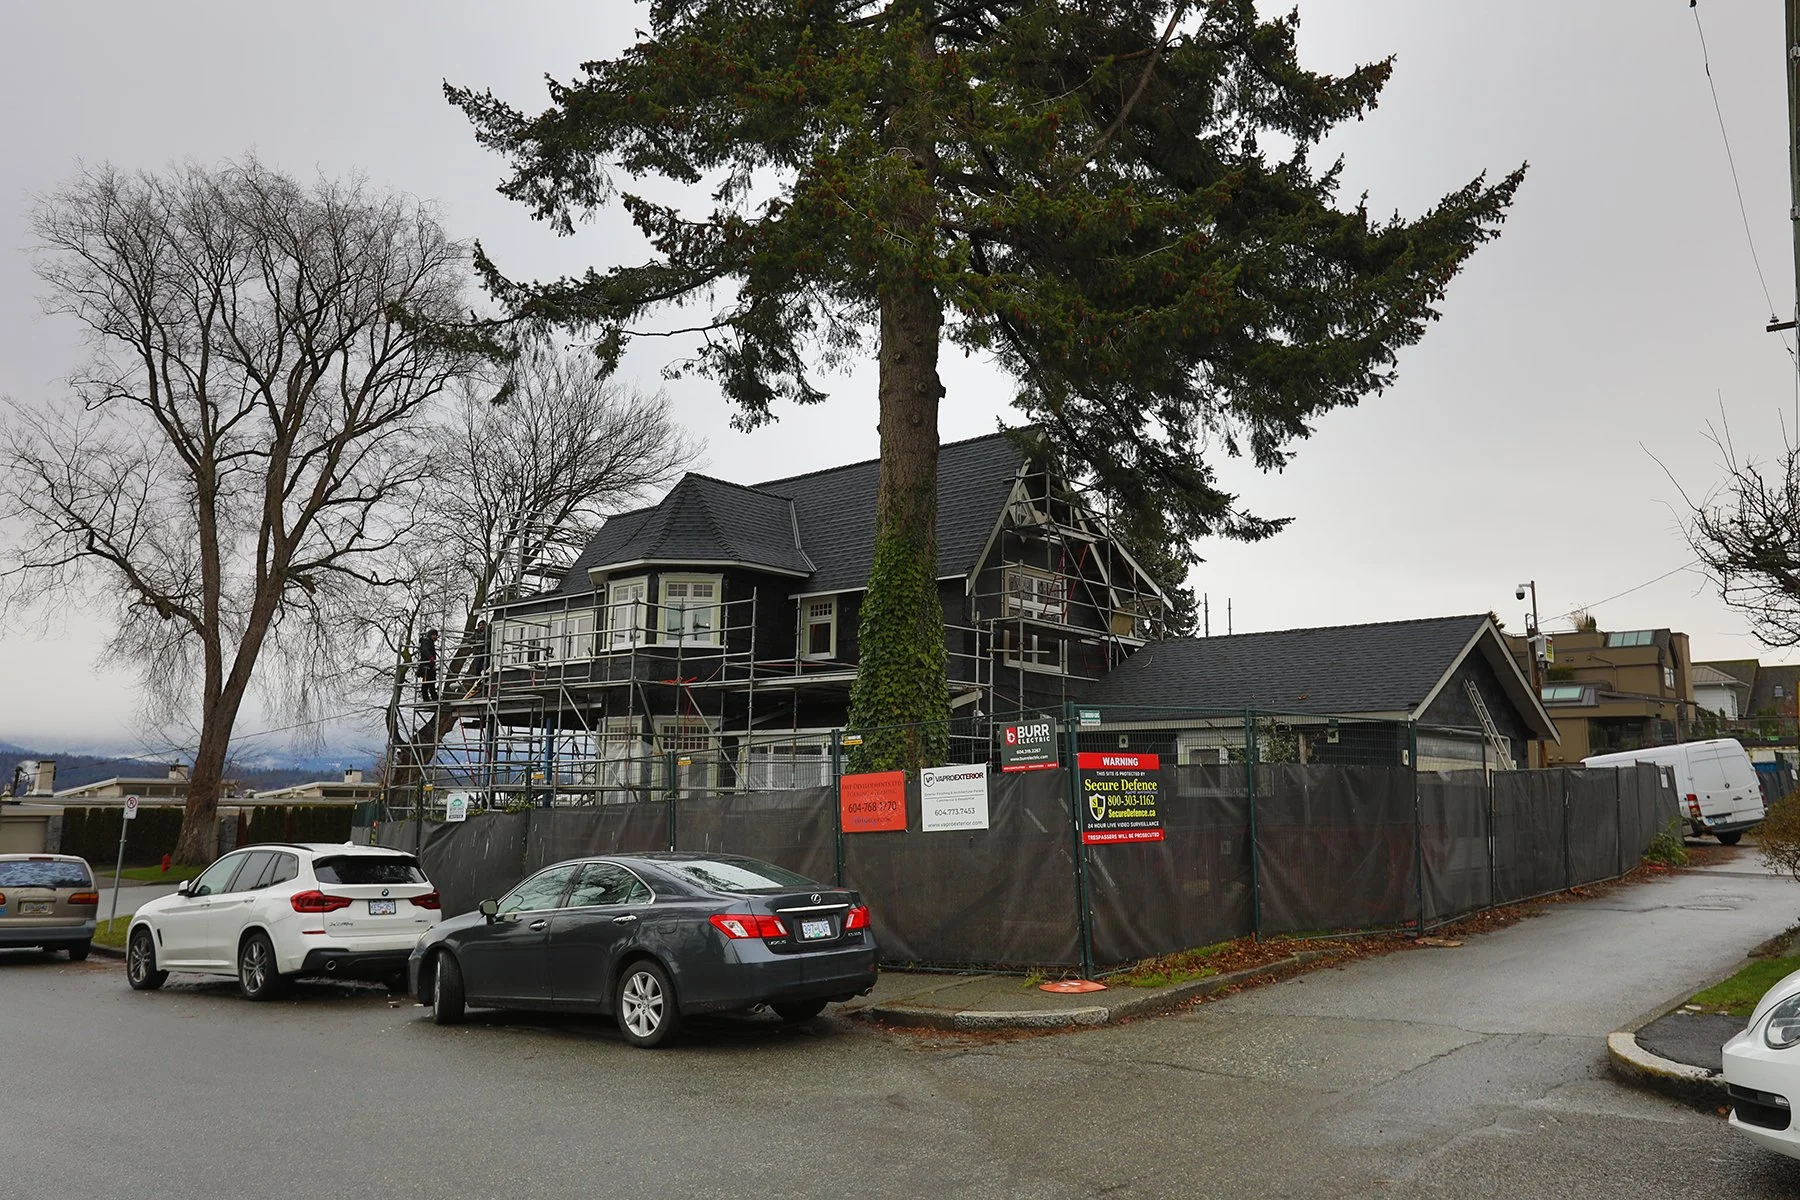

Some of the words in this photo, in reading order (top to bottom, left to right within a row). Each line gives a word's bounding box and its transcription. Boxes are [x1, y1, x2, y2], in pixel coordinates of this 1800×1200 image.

[1017, 724, 1050, 738] BURR
[1102, 756, 1138, 766] WARNING
[935, 772, 984, 782] VAPROEXTERIOR
[1084, 778, 1119, 791] Secure
[1120, 778, 1157, 791] Defence
[1107, 794, 1155, 806] 800-303-1162
[935, 808, 975, 816] 604.773.7453
[1108, 808, 1156, 818] SecureDefence.ca
